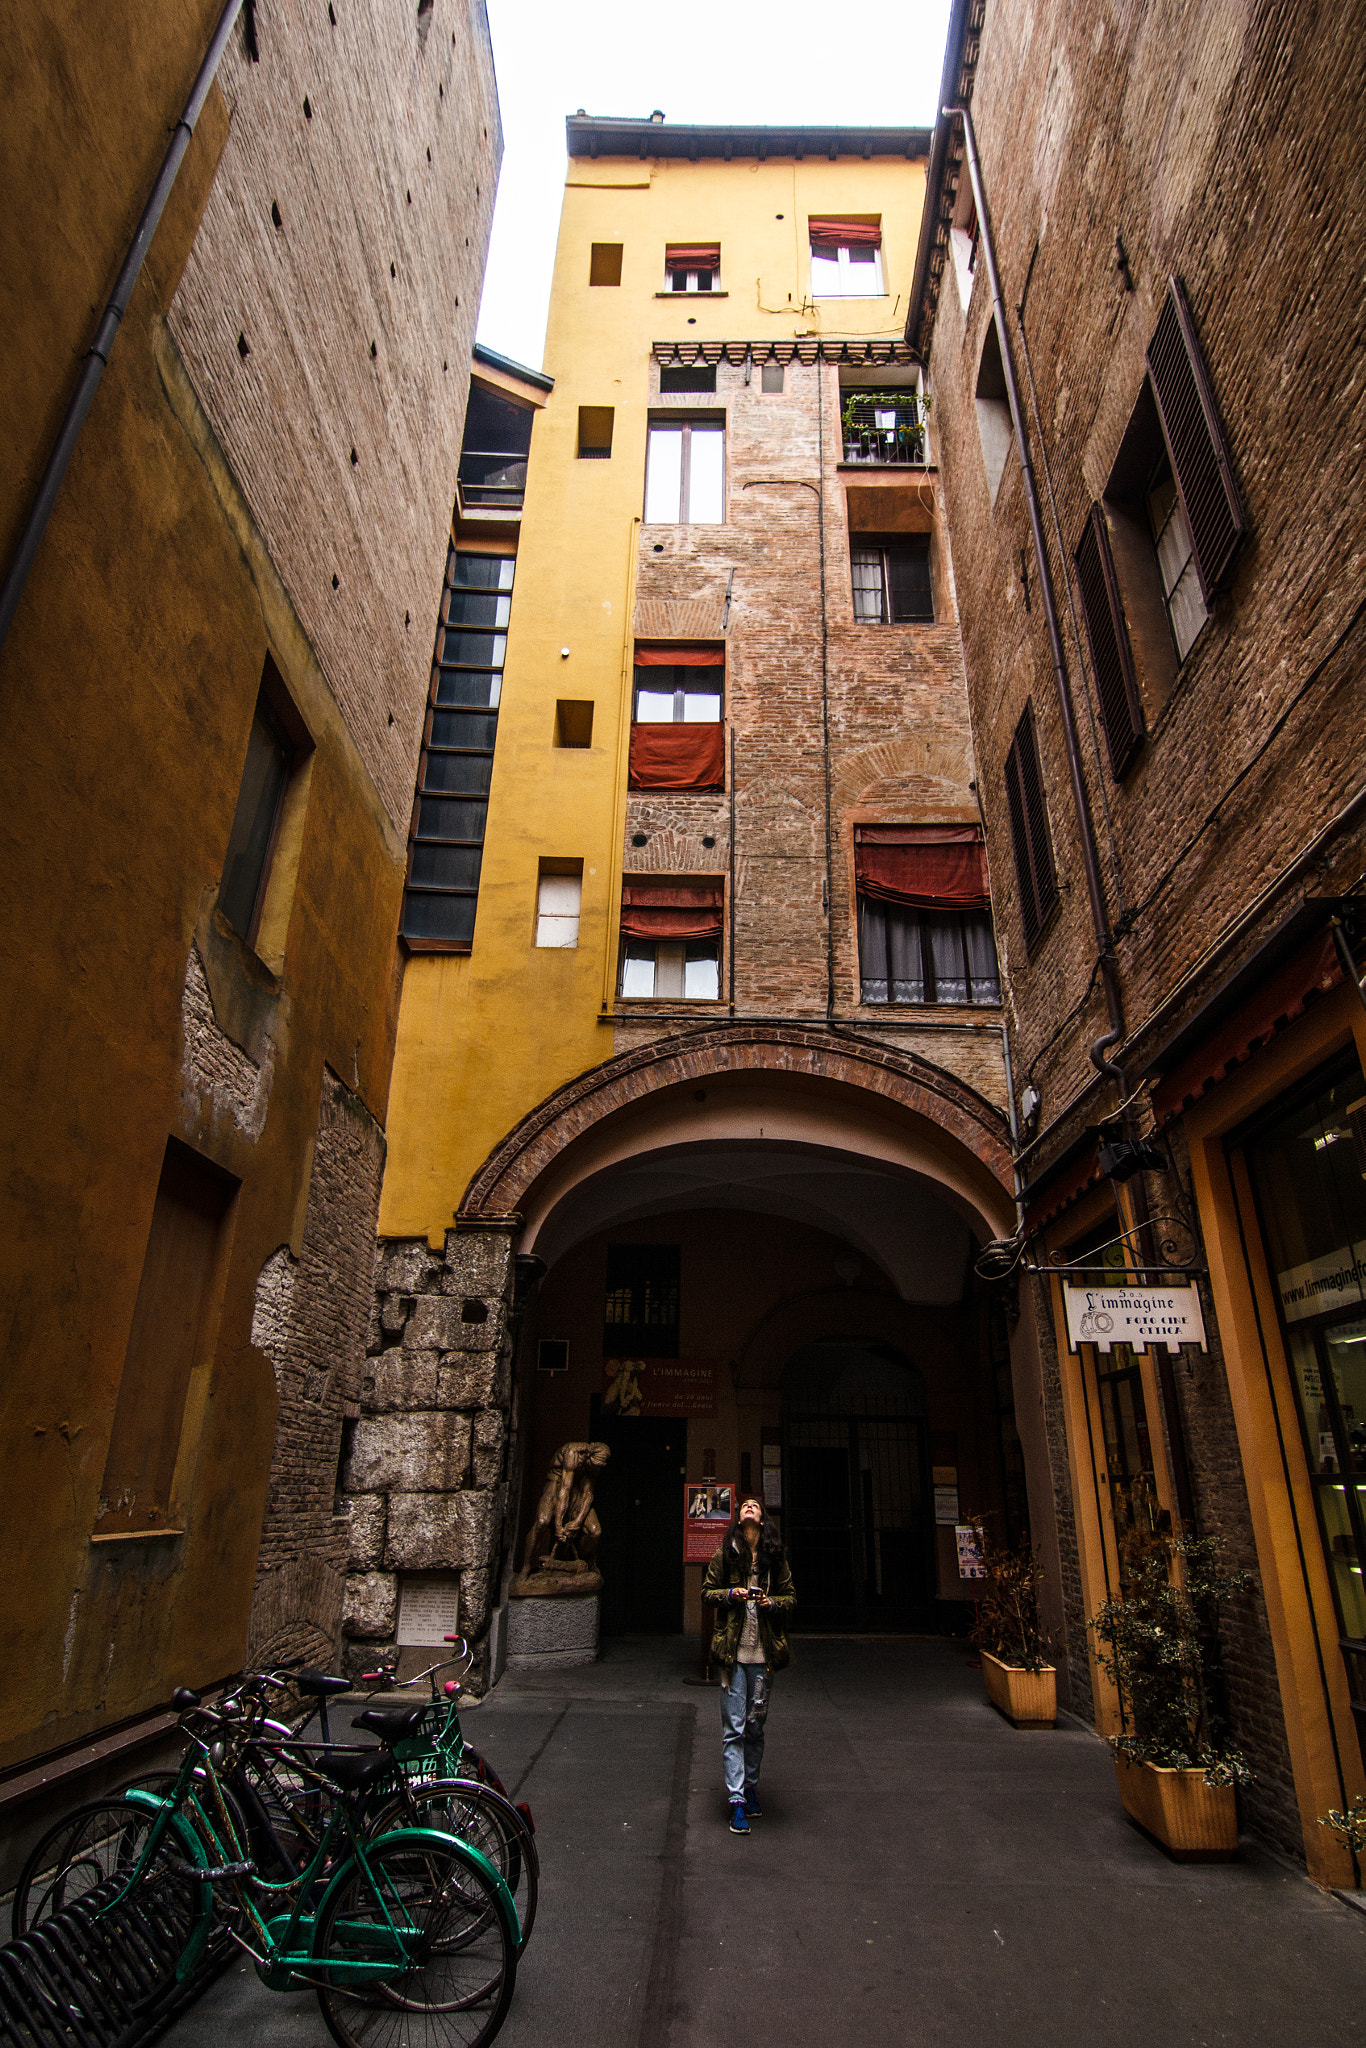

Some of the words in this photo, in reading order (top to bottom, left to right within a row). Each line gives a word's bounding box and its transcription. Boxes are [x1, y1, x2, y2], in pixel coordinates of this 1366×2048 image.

[1086, 1292, 1174, 1313] L'immagine
[1126, 1317, 1156, 1325] FOTO
[1161, 1317, 1188, 1325] CINE
[1139, 1327, 1183, 1335] OTTICA
[653, 1367, 713, 1377] L'IMMAGINE
[264, 1769, 294, 1812] MBM
